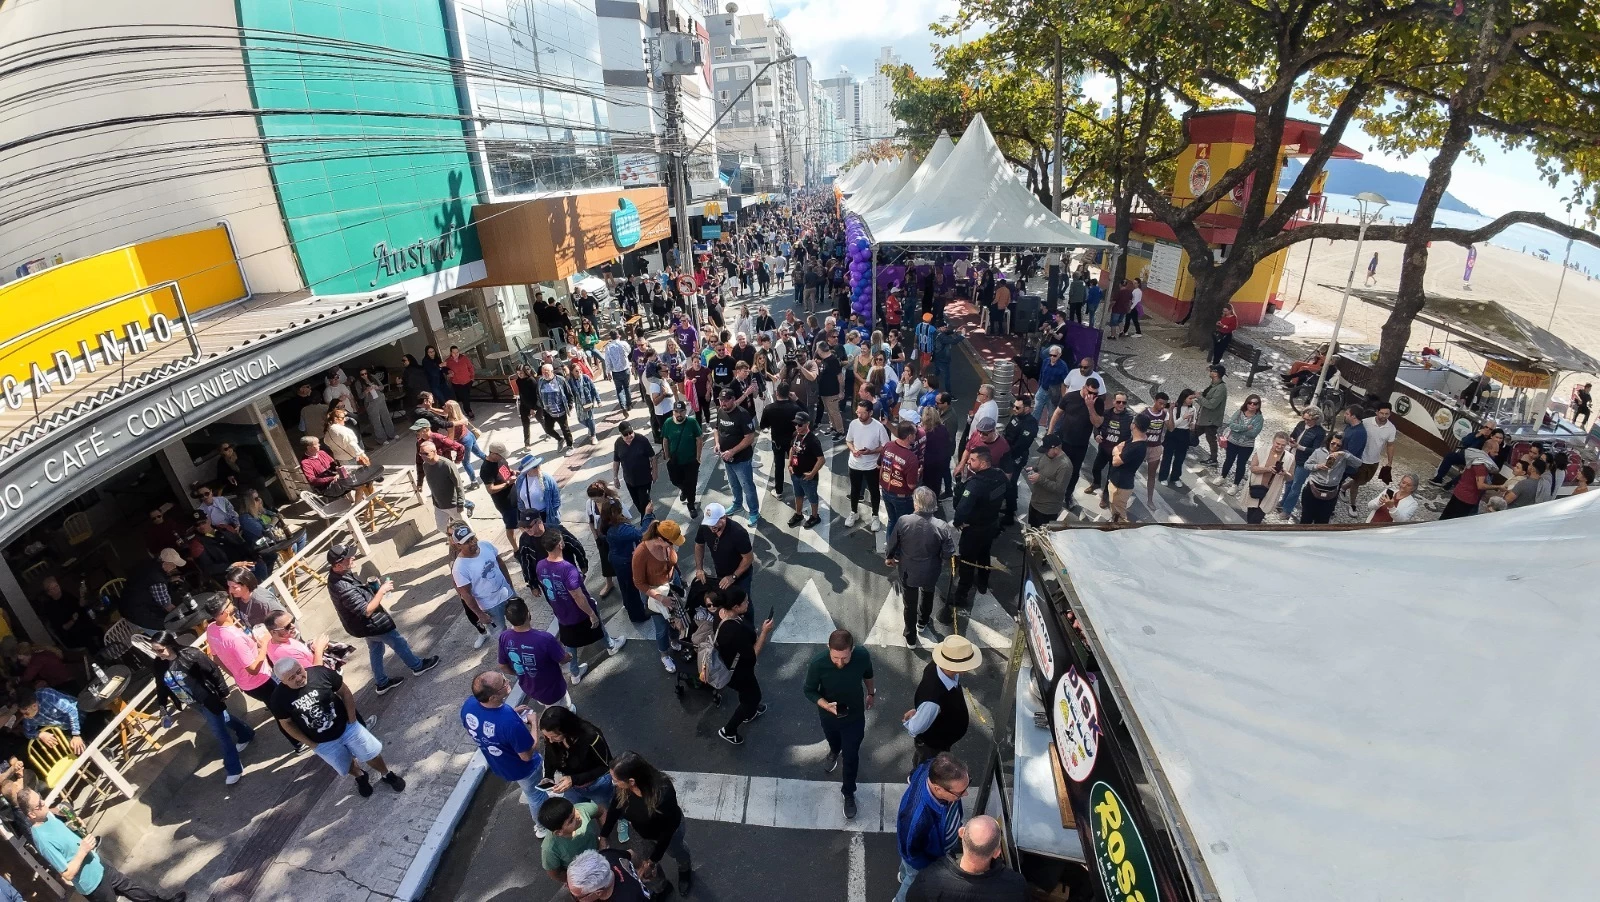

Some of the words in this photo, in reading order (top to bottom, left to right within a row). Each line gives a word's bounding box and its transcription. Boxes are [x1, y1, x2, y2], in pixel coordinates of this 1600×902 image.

[370, 223, 458, 287] Austral
[44, 428, 110, 483] CAFÉ
[126, 354, 281, 437] CONVENIÊNCIA
[1063, 679, 1094, 757] GELO
[1068, 664, 1104, 745] DISK
[1096, 830, 1123, 902] ALIMEN
